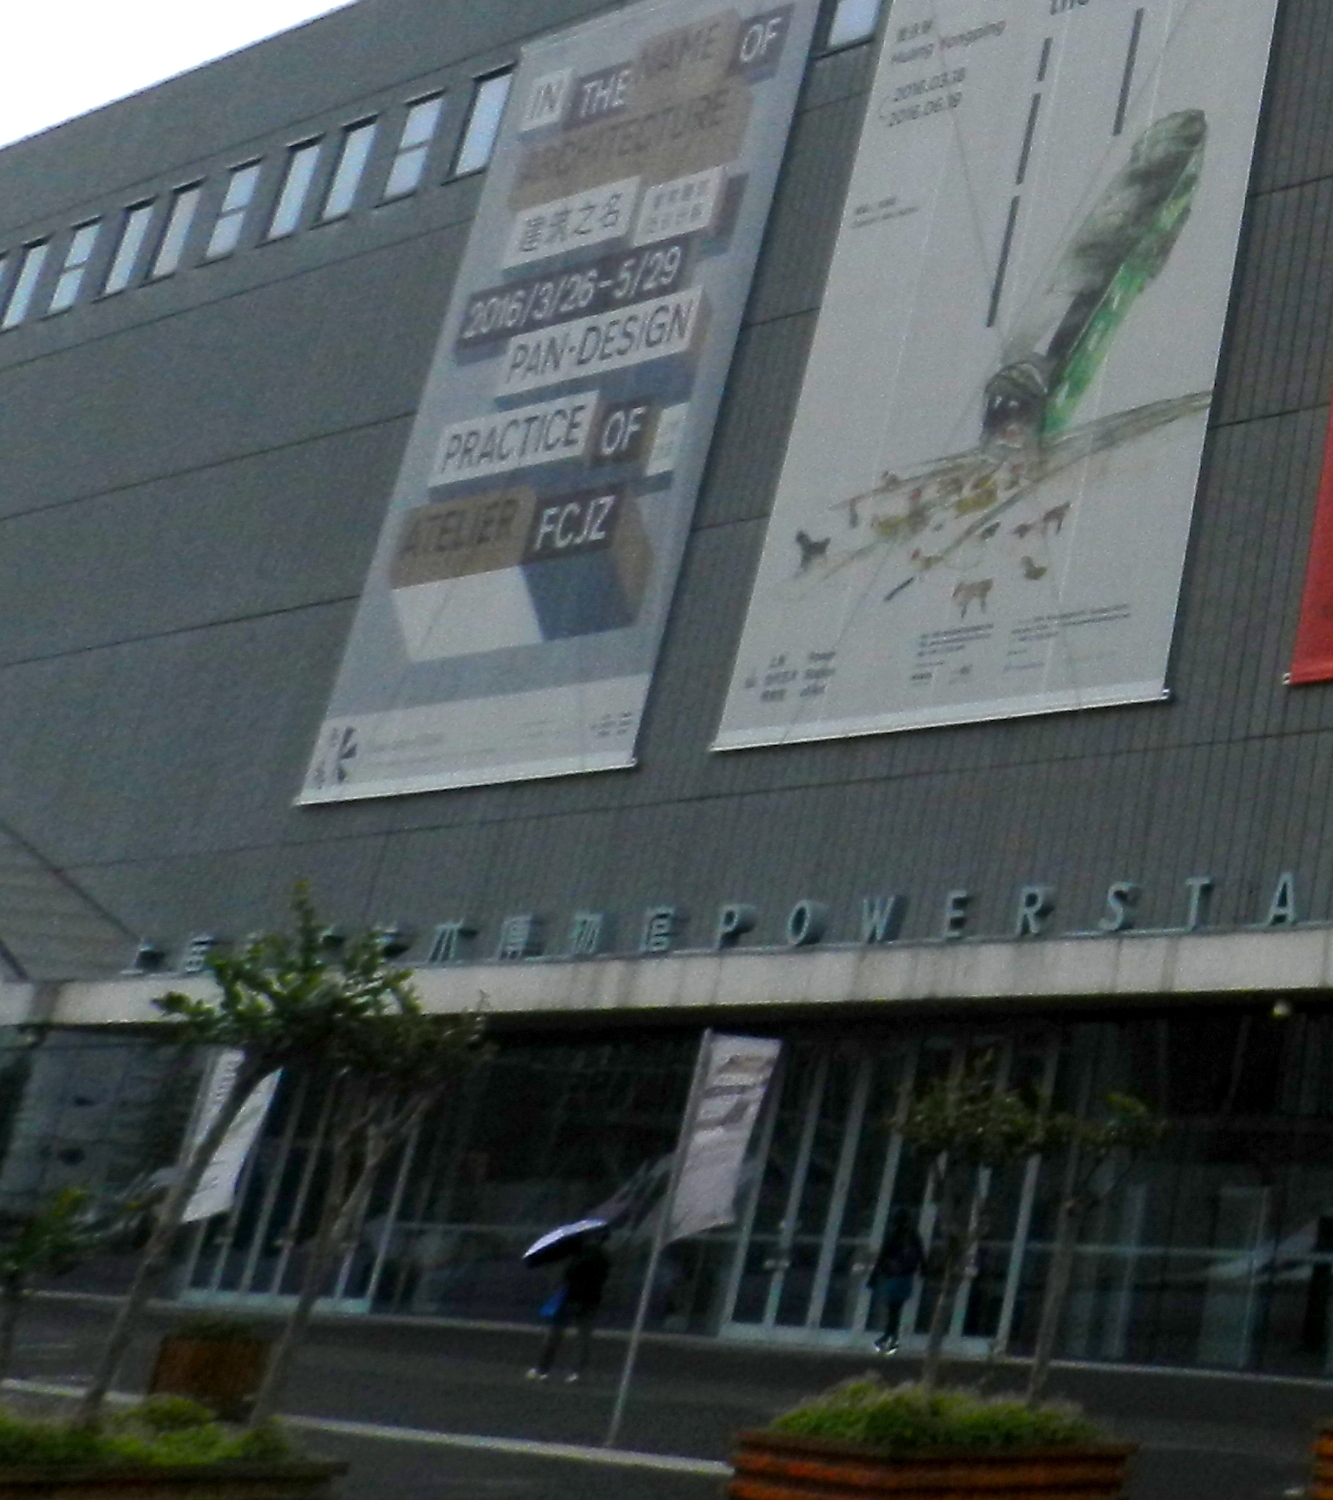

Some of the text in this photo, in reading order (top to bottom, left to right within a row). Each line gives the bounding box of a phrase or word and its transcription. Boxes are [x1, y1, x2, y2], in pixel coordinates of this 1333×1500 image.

[579, 68, 632, 118] THE
[739, 16, 782, 64] OF
[441, 403, 586, 475] PRACTICE
[601, 405, 648, 456] OF
[535, 495, 615, 551] FCJZ
